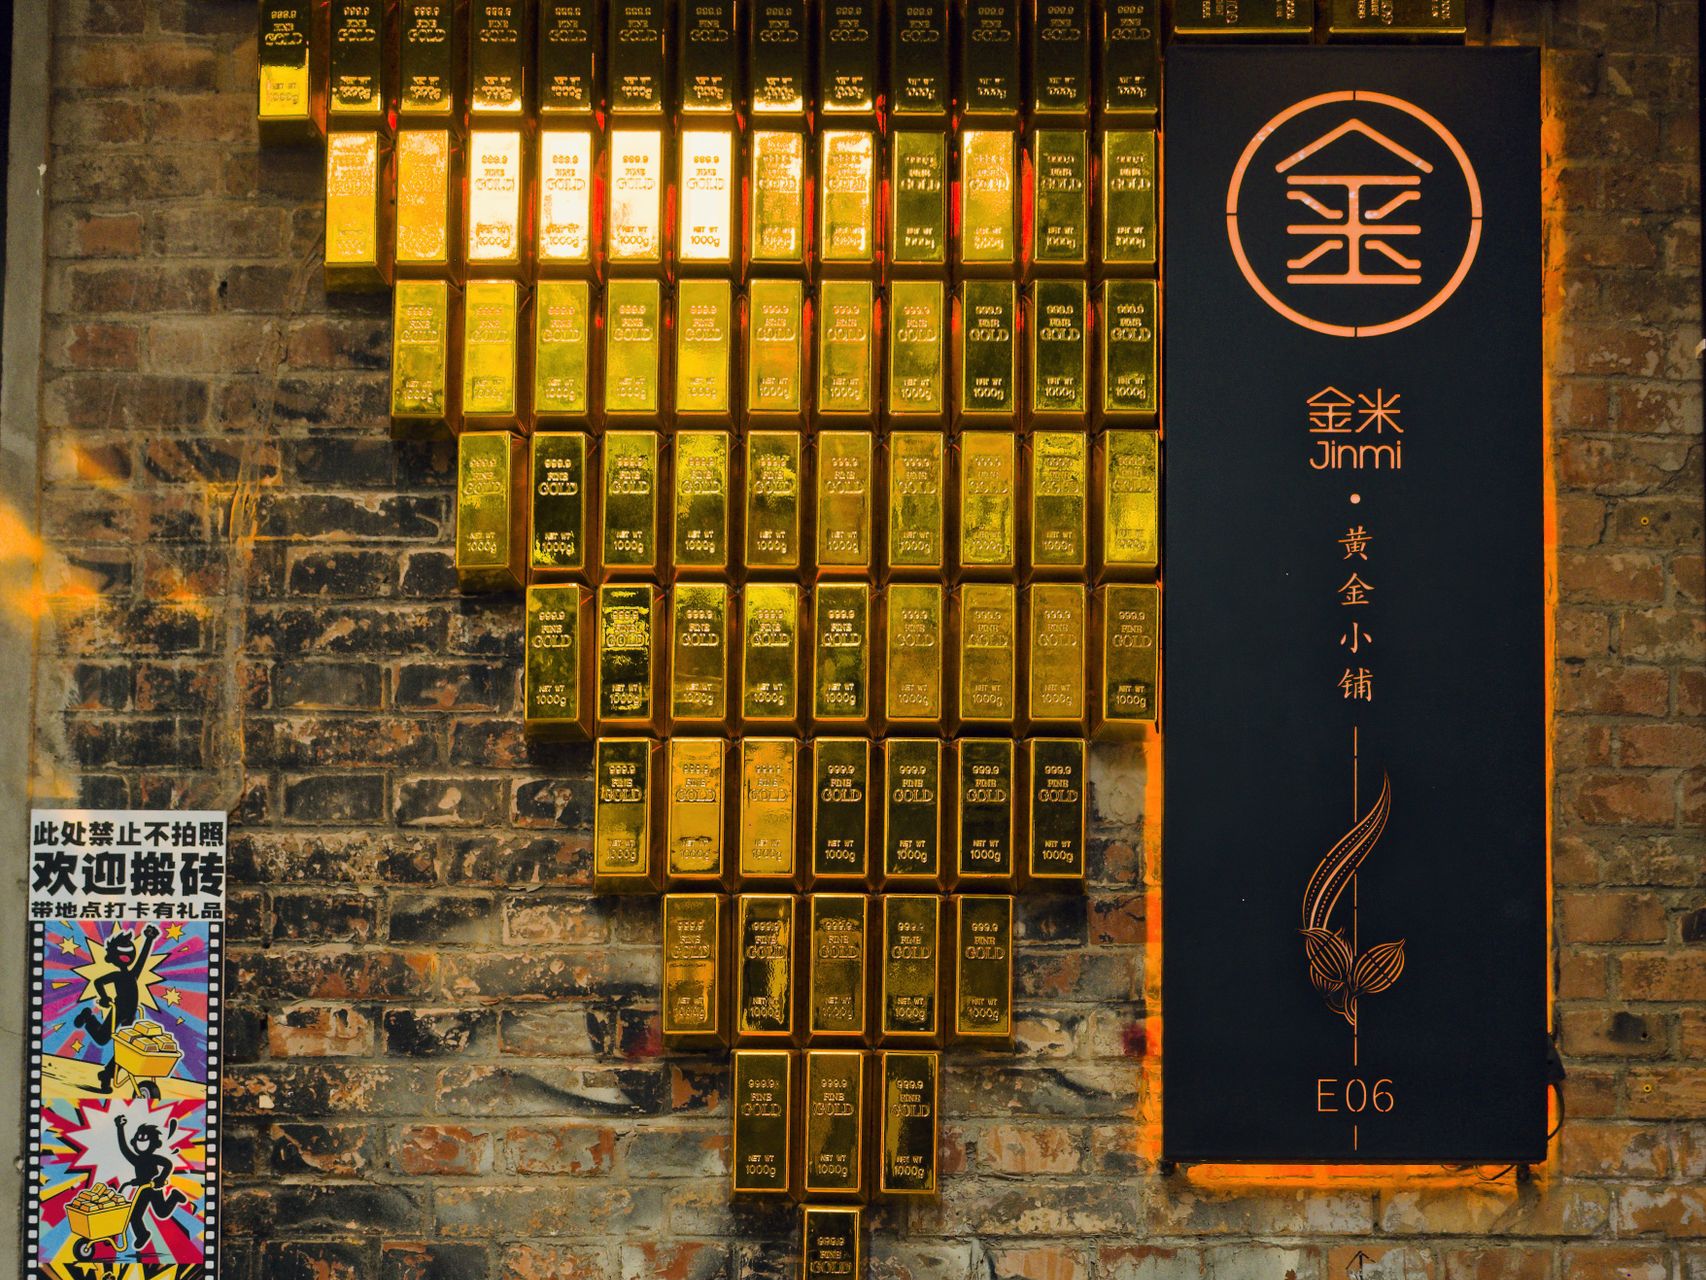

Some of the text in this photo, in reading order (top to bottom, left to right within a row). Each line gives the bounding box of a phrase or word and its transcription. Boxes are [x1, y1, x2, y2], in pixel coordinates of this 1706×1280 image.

[688, 179, 728, 193] GOLD
[970, 329, 1010, 343] GOLD
[1040, 328, 1081, 342] GOLD
[1306, 386, 1404, 434] 金米
[1309, 440, 1402, 469] Jinmi
[538, 482, 578, 496] GOLD
[611, 480, 651, 494] GOLD
[539, 612, 566, 621] 999.9
[1119, 612, 1146, 621] 999.9
[1337, 525, 1375, 702] 黄金小铺
[533, 634, 573, 648] GOLD
[822, 633, 862, 647] GOLD
[1112, 634, 1153, 648] GOLD
[536, 694, 567, 708] 1000g
[1116, 695, 1147, 708] 1000g
[828, 765, 855, 774] 999.9
[900, 766, 927, 775] 999.9
[972, 766, 999, 775] 999.9
[1044, 766, 1071, 775] 999.9
[822, 788, 862, 802] GOLD
[893, 789, 934, 803] GOLD
[966, 789, 1006, 803] GOLD
[1038, 789, 1078, 803] GOLD
[33, 821, 224, 847] 此处禁止不拍照
[825, 849, 856, 862] 1000g
[897, 849, 928, 863] 1000g
[970, 849, 1001, 862] 1000g
[1042, 850, 1073, 864] 1000g
[32, 851, 224, 897] 欢迎搬砖
[32, 901, 223, 919] 带地点打卡有礼品
[972, 923, 999, 932] 999.9
[746, 945, 786, 959] GOLD
[891, 946, 932, 960] GOLD
[965, 946, 1006, 960] GOLD
[969, 1008, 1000, 1022] 1000g
[749, 1079, 776, 1089] 999.9
[821, 1079, 848, 1089] 999.9
[1317, 1078, 1394, 1112] E06
[742, 1102, 783, 1116] GOLD
[814, 1102, 855, 1116] GOLD
[890, 1103, 931, 1117] GOLD
[746, 1164, 777, 1178] 1000g
[818, 1164, 849, 1177] 1000g
[894, 1165, 925, 1178] 1000g
[811, 1260, 852, 1274] GOLD
